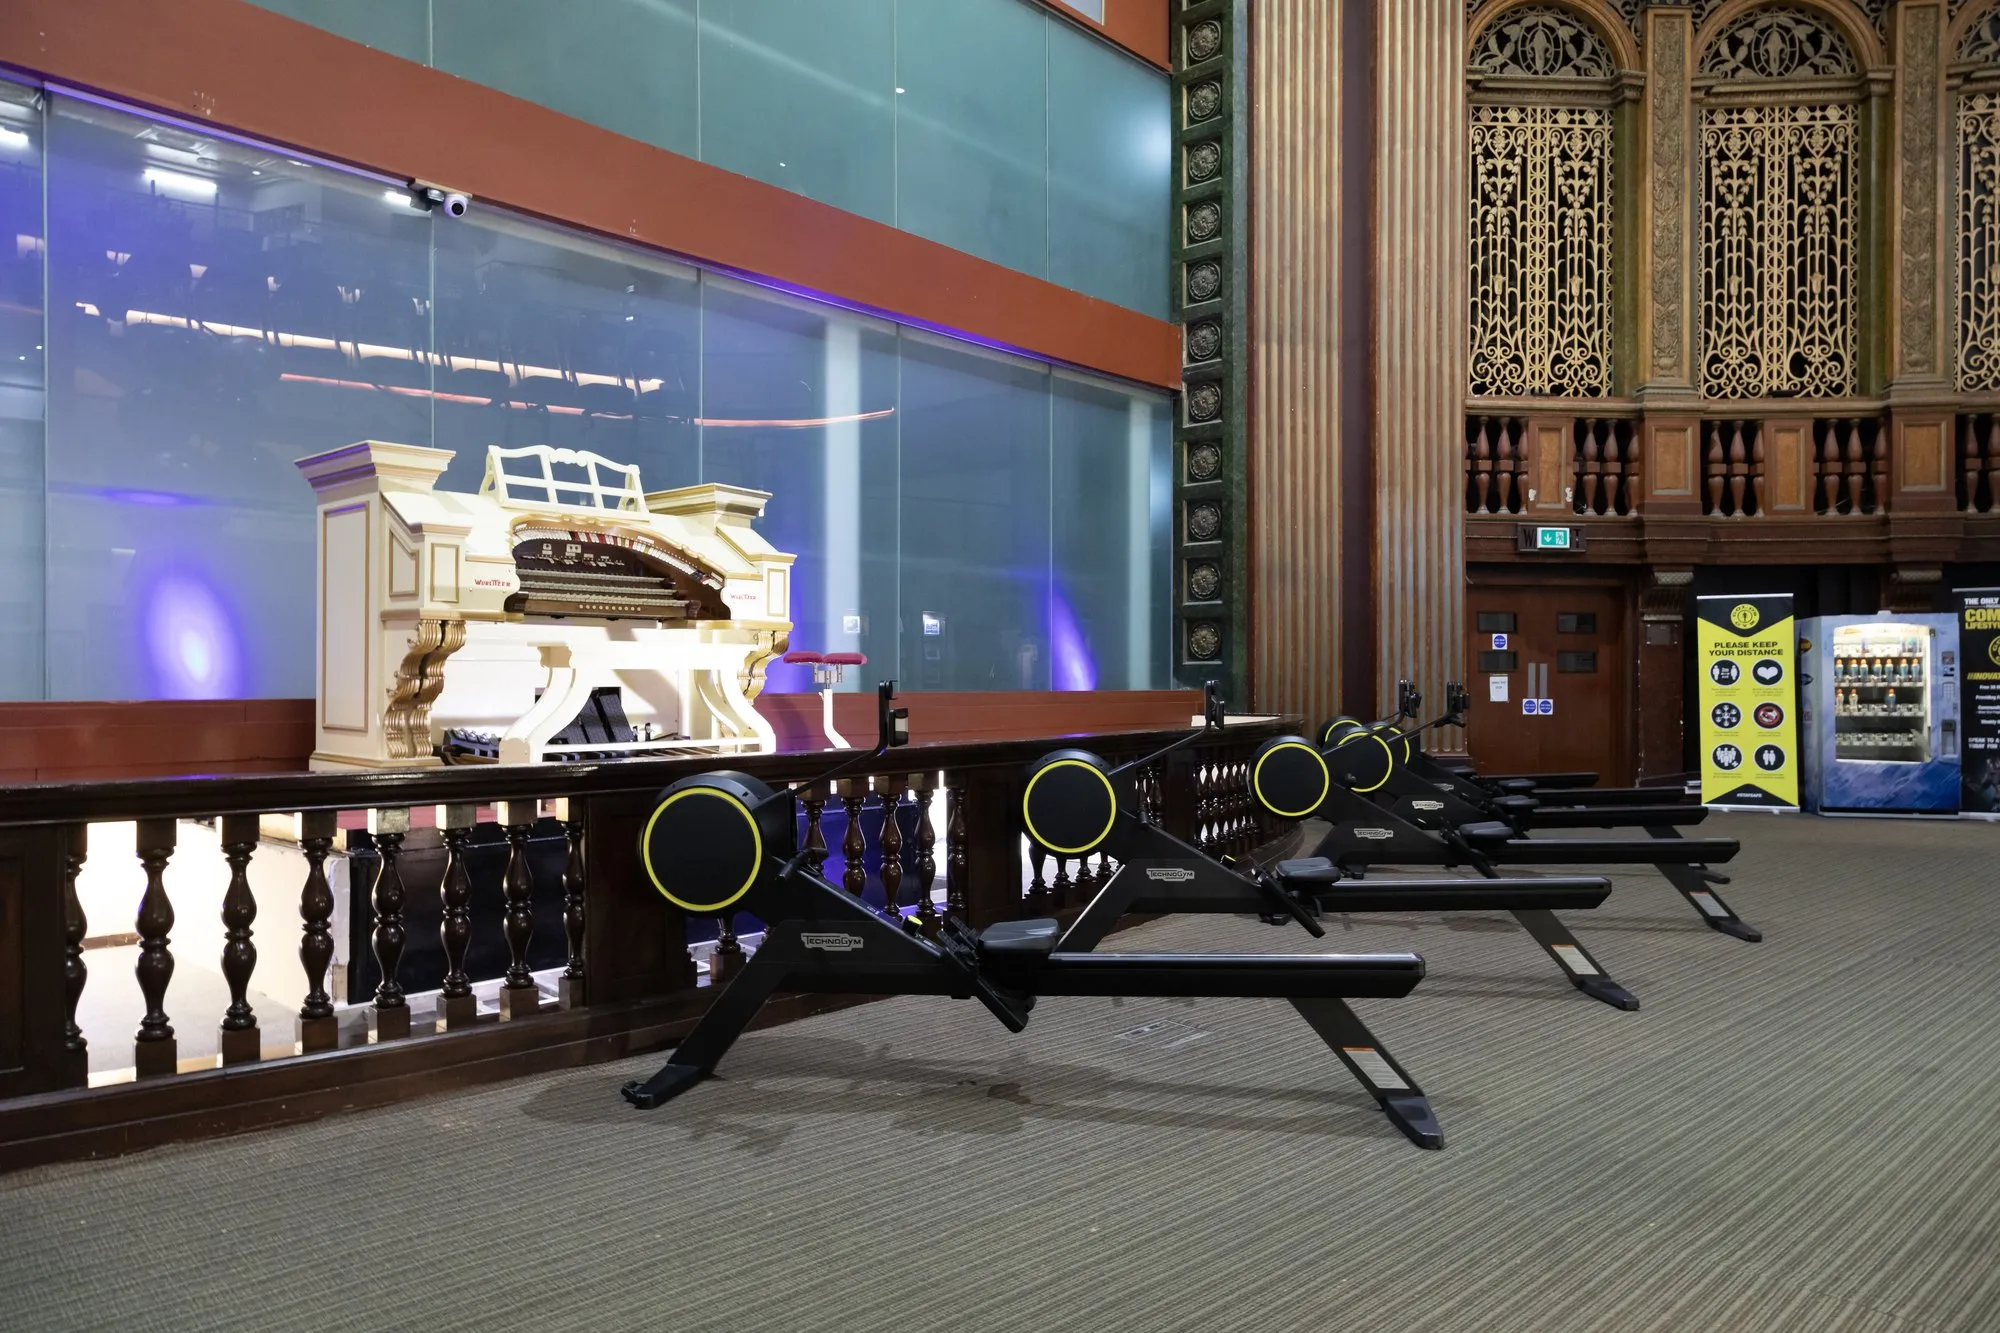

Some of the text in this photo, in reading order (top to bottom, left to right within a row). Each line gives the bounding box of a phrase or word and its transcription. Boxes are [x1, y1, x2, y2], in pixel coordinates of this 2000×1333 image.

[1965, 609, 2000, 621] COM
[1714, 641, 1749, 649] PLEASE
[1736, 648, 1784, 656] DISTANCE
[1147, 869, 1194, 880] TECHNOGYM
[802, 934, 862, 949] TECHNOGYM
